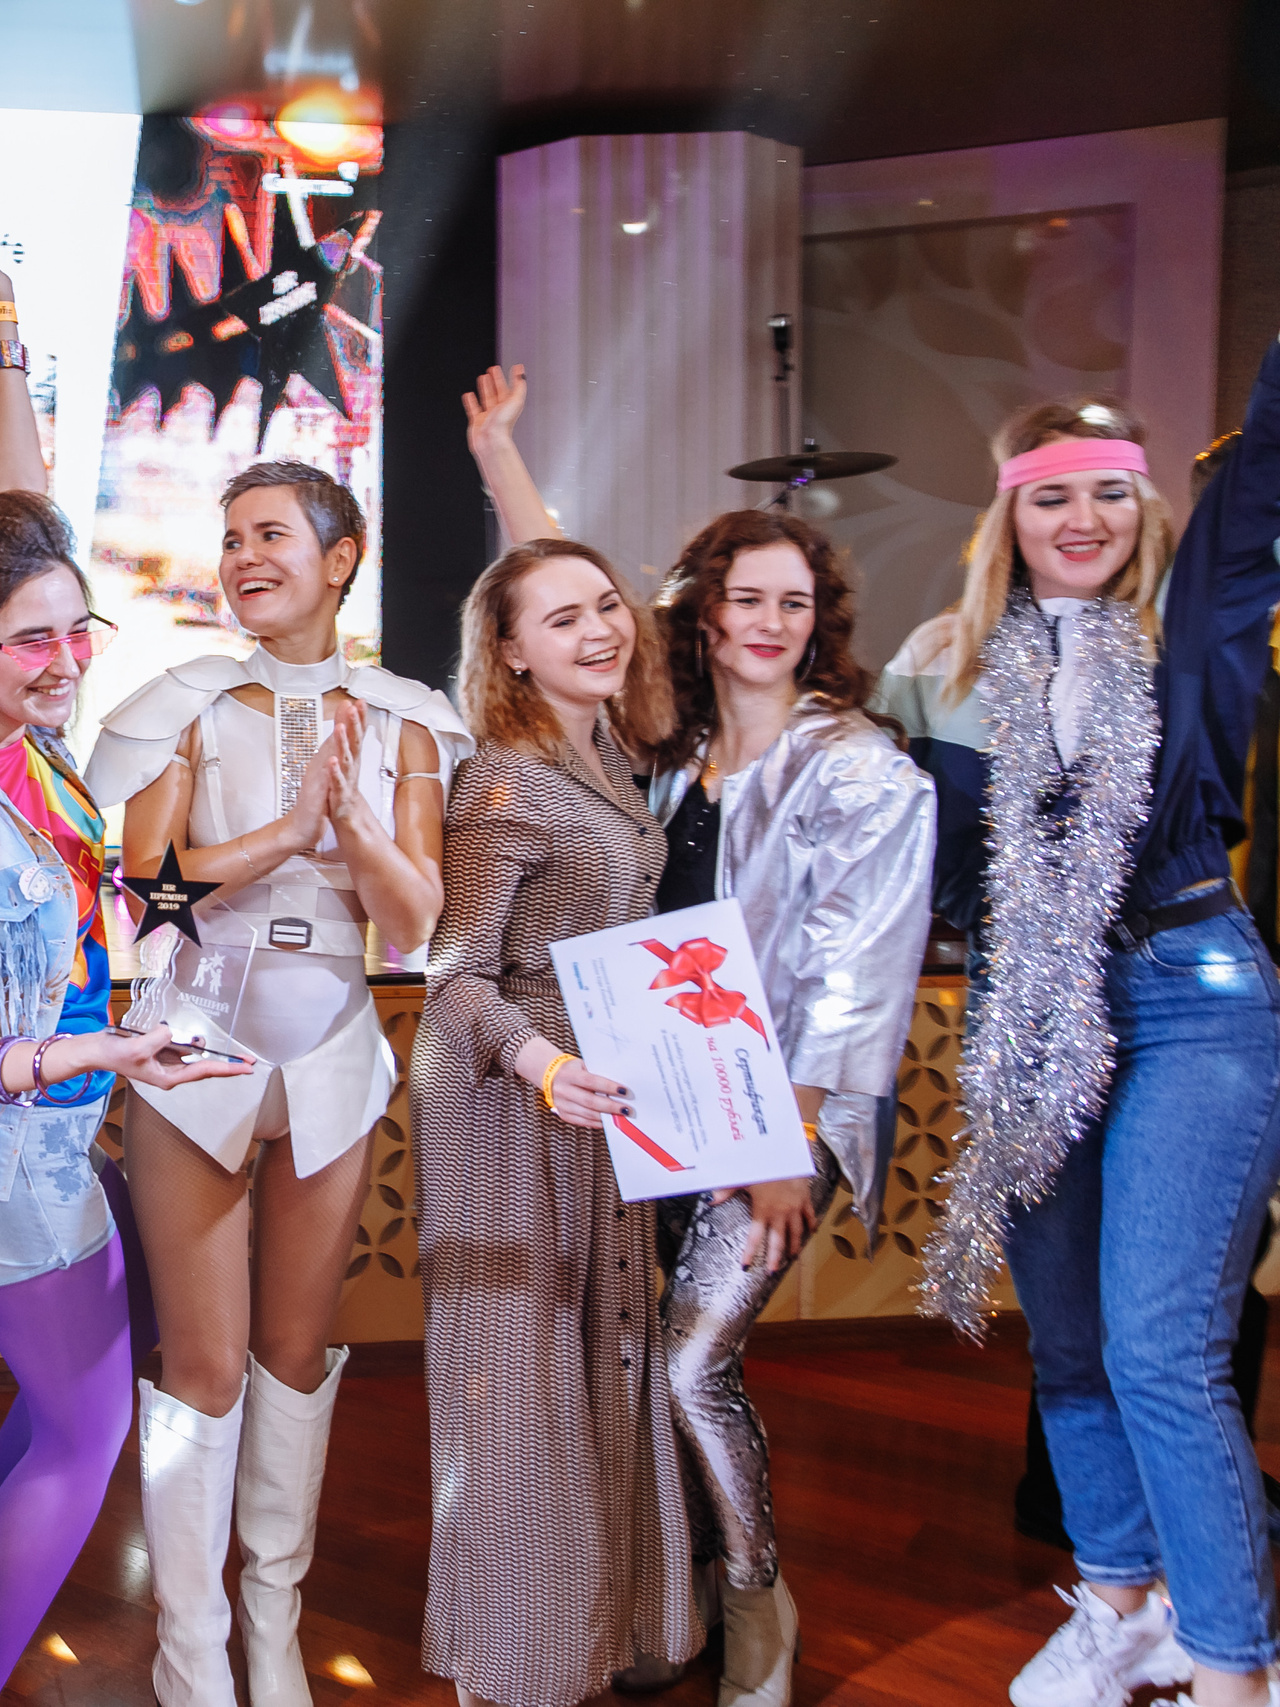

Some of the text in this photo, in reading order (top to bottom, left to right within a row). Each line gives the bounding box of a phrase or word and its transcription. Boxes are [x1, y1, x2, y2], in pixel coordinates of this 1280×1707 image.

[149, 892, 188, 902] ПРЕМИЯ
[157, 901, 180, 910] 2019
[176, 991, 230, 1014] ЛУЧШИЙ
[706, 1036, 745, 1141] на 10000 рублей
[734, 1047, 768, 1135] Сертификат
